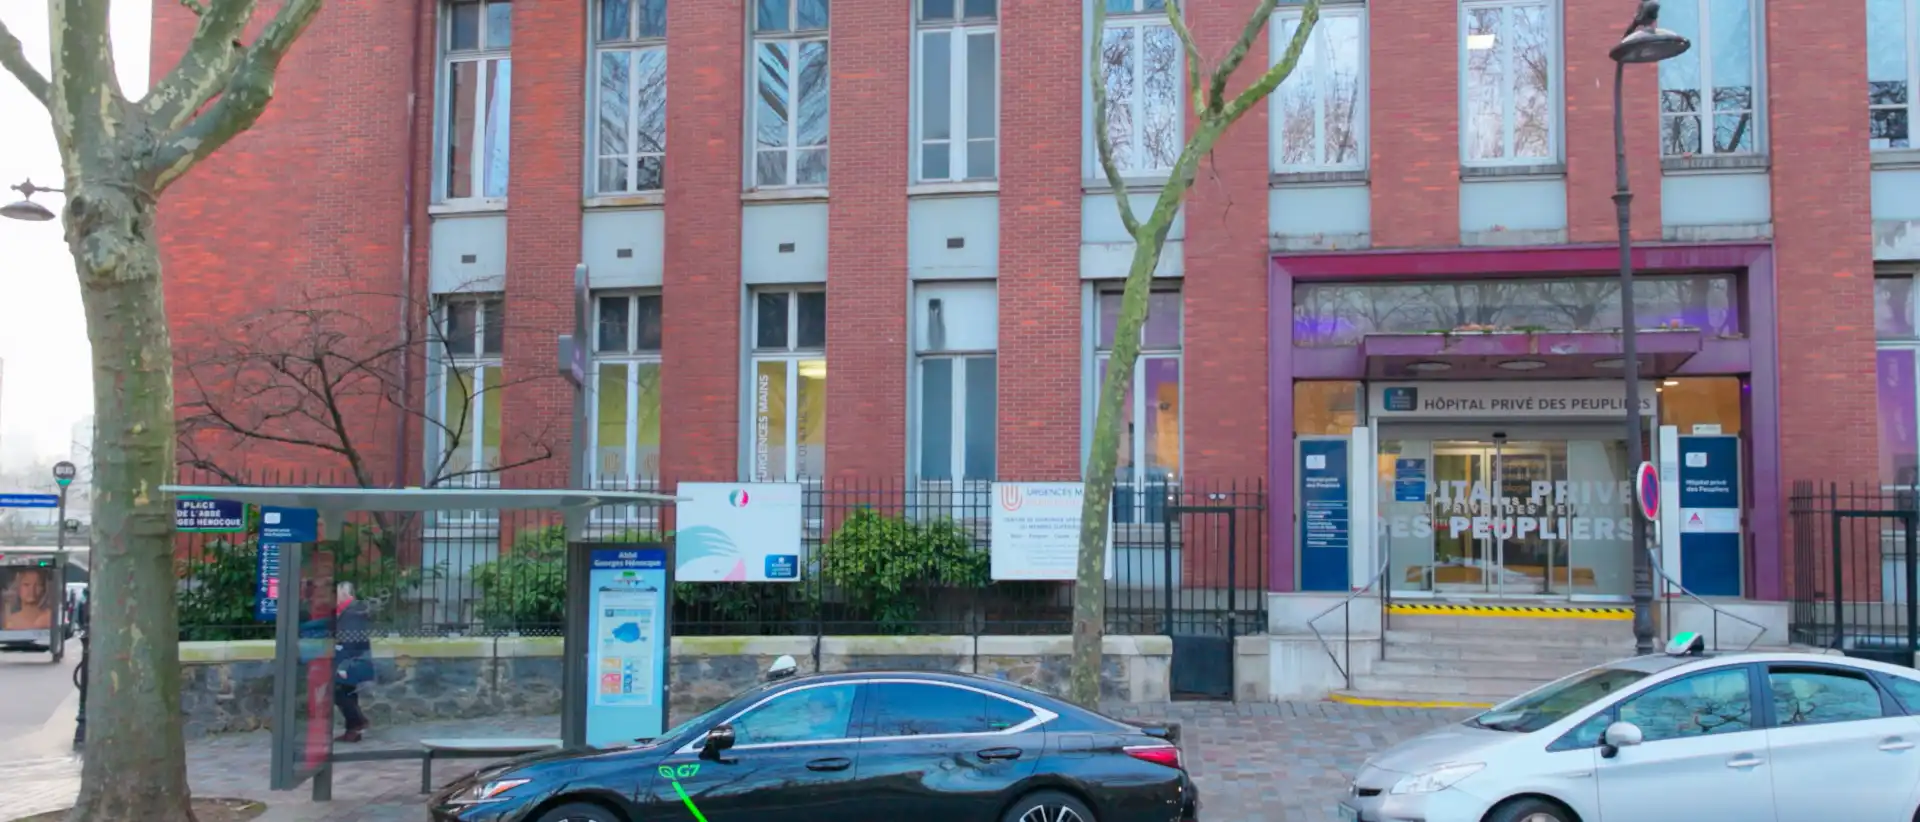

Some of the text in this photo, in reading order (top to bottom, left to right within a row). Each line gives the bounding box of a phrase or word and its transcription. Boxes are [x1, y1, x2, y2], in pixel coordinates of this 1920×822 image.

[1424, 396, 1487, 411] HÔPITAL
[1490, 396, 1534, 411] PRIVÉ
[1538, 398, 1567, 411] DES
[1571, 398, 1651, 411] PEUPLIS
[757, 374, 769, 478] URGENCES MAINS
[1027, 487, 1071, 496] URGENCES
[183, 501, 216, 509] PLACE
[176, 510, 189, 518] DE
[1449, 516, 1633, 541] PEUPLIERS
[676, 764, 700, 777] G7
